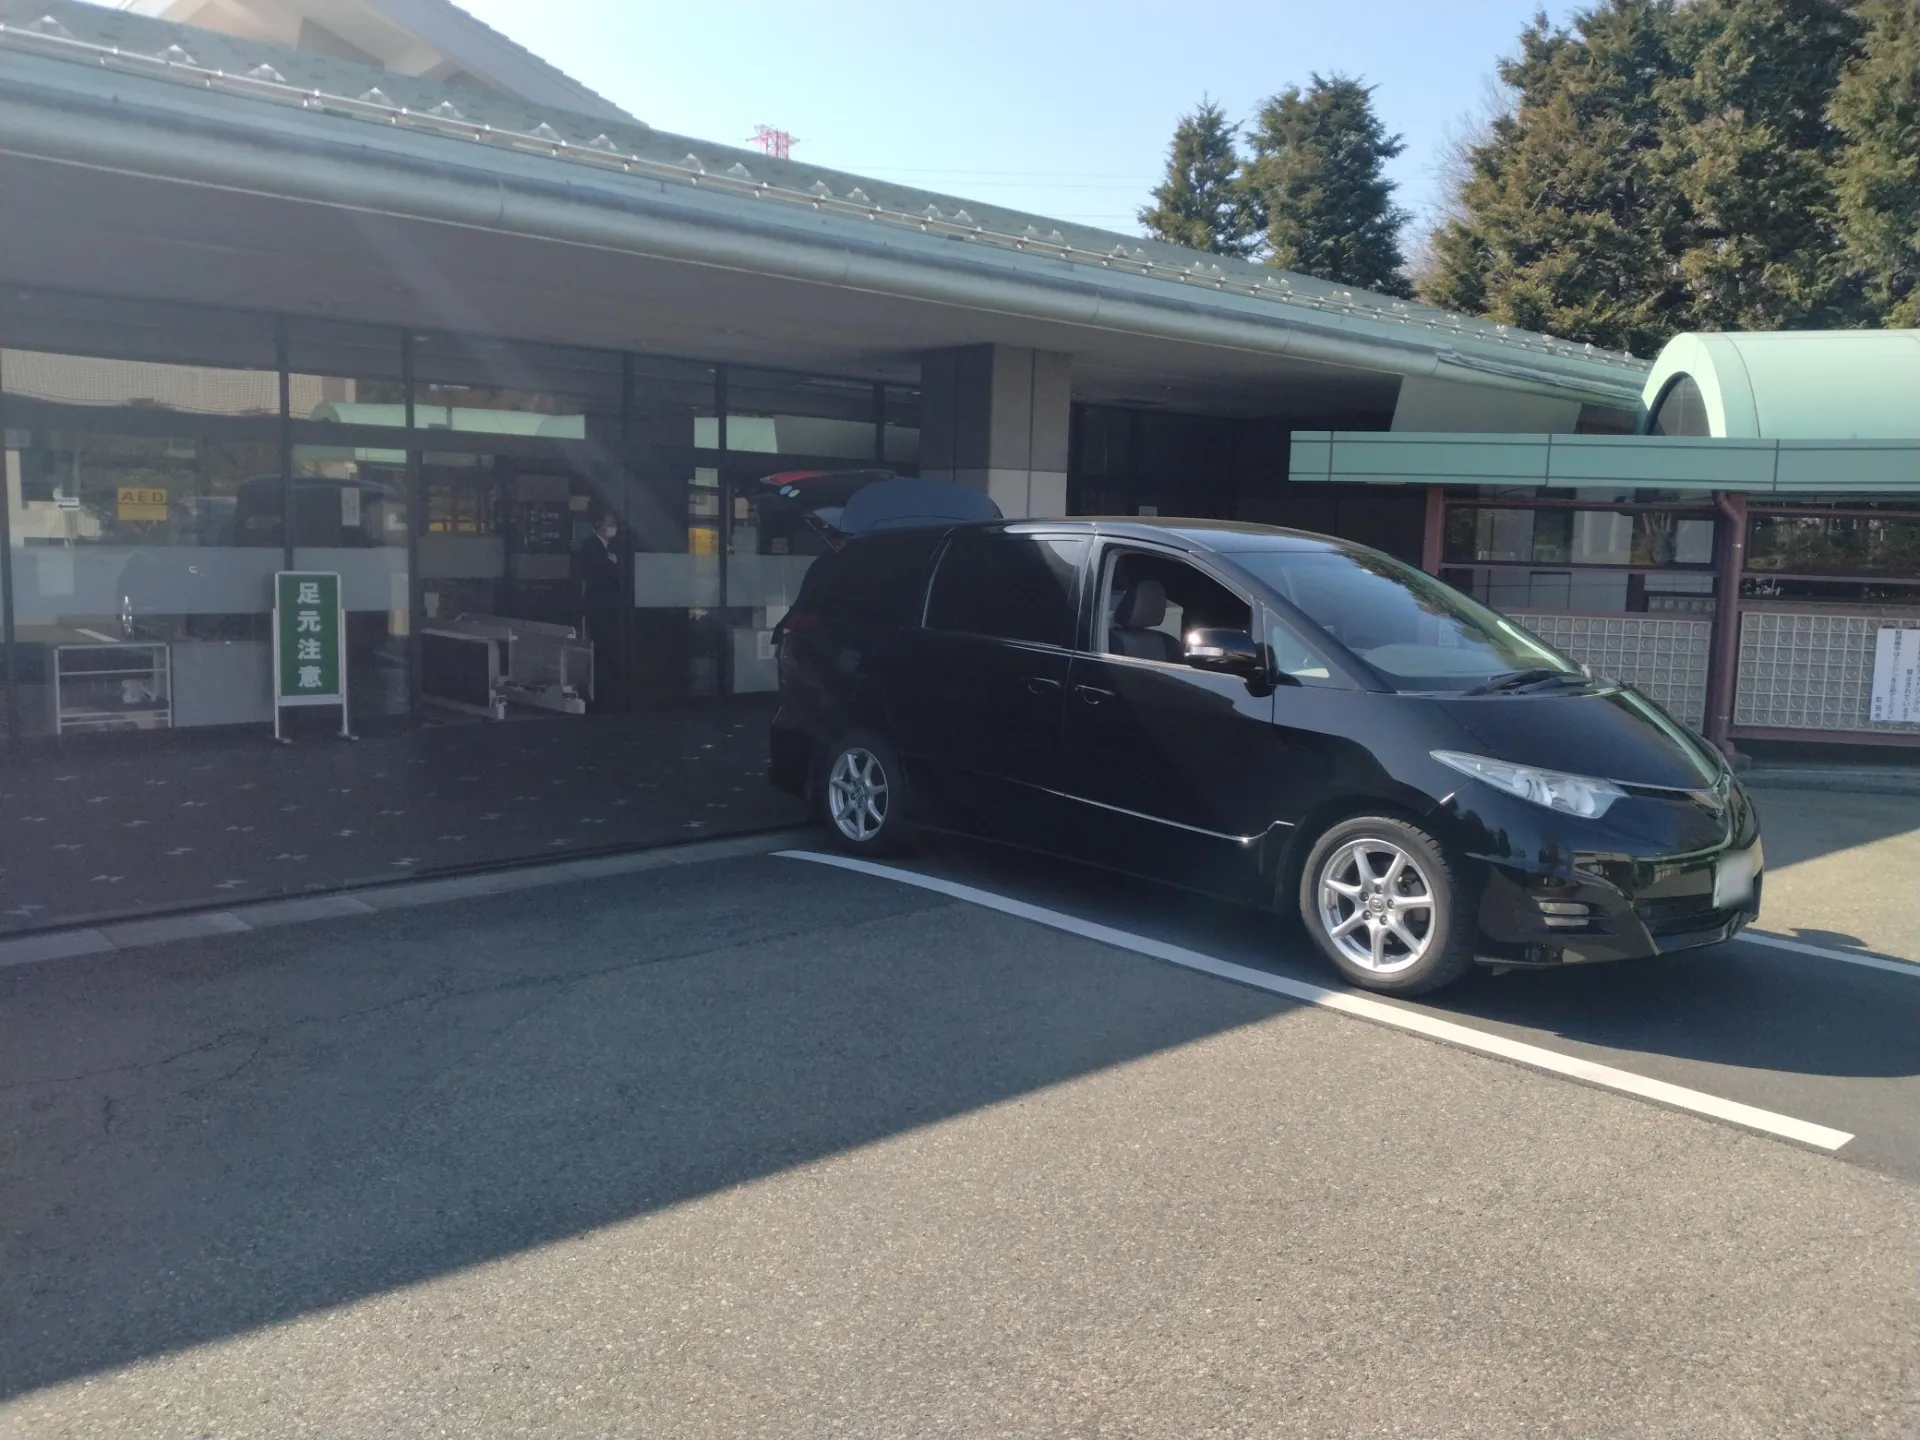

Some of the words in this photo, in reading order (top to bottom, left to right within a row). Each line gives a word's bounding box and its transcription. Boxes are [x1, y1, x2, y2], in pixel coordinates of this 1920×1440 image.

[121, 491, 164, 503] AED
[297, 582, 322, 688] 足元注意
